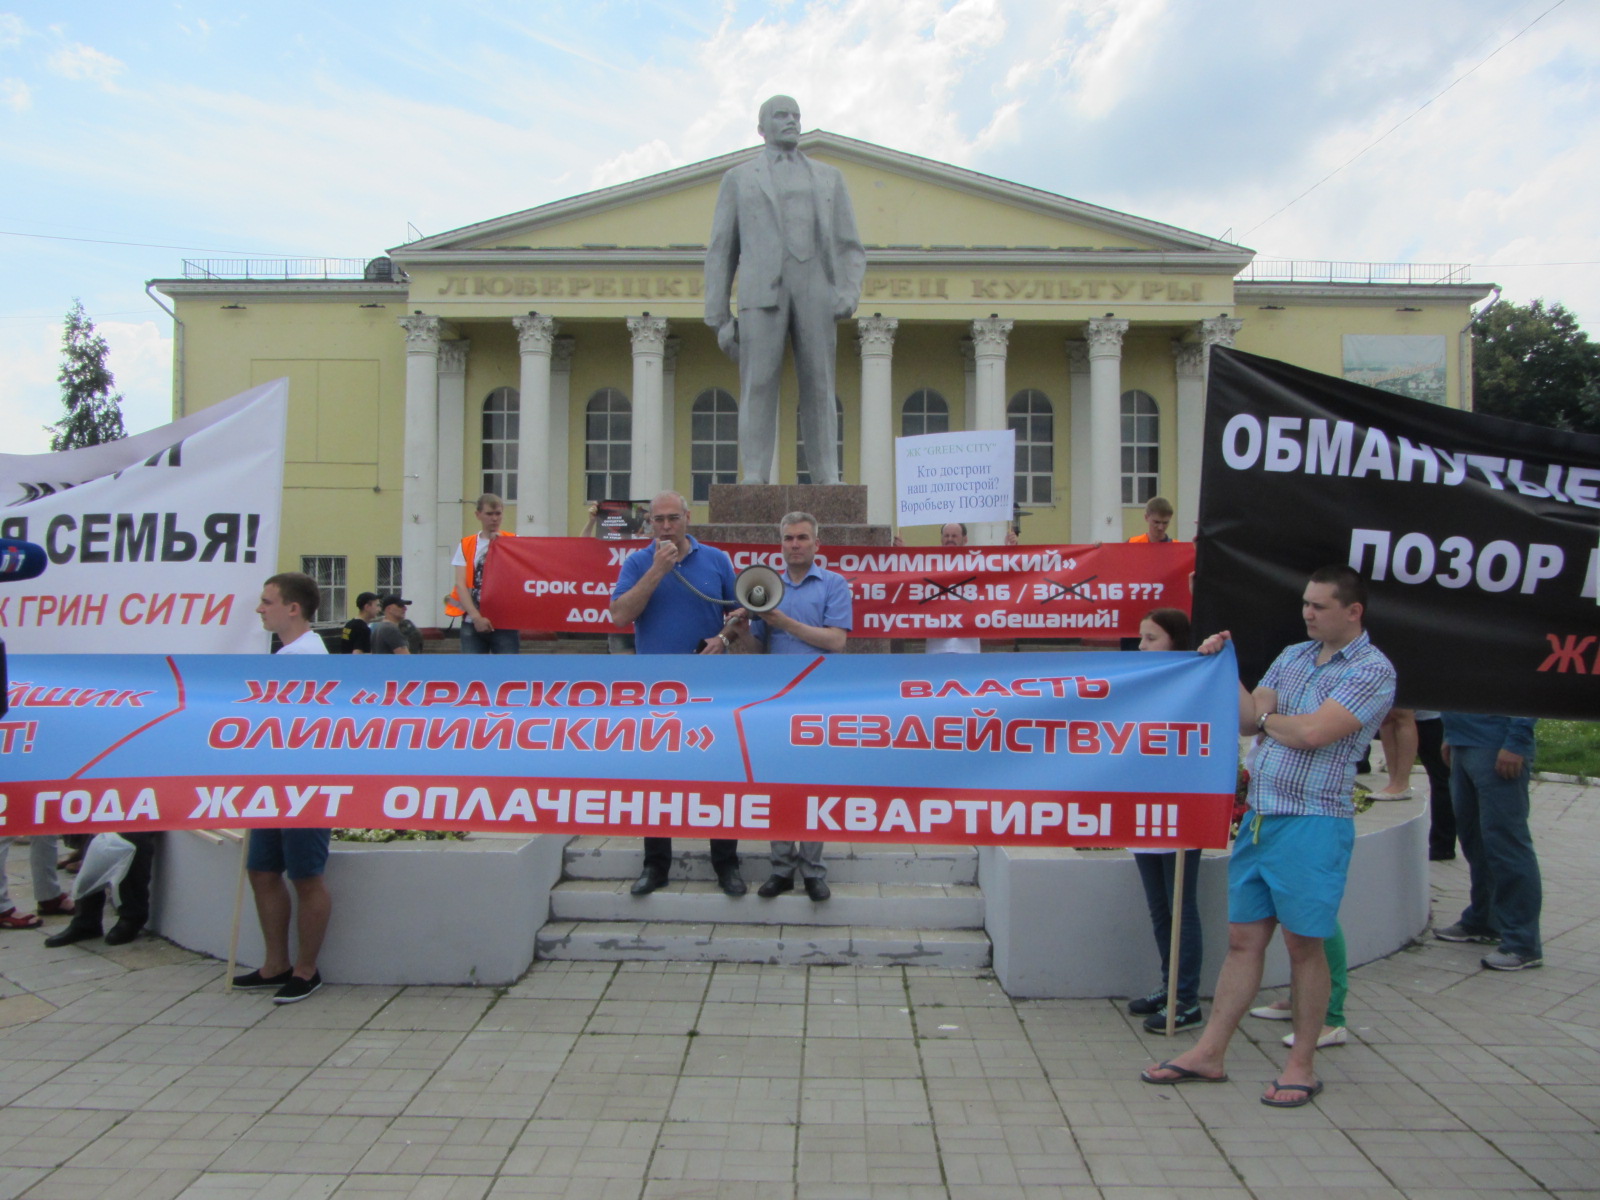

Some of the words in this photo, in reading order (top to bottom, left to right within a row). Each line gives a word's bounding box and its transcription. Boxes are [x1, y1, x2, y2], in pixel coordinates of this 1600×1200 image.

[437, 276, 704, 299] ЛЮБЕРЕЦК
[864, 277, 948, 300] РЕЦ
[971, 277, 1204, 302] КУЛЬТУРЫ
[917, 465, 937, 478] Кто
[940, 464, 991, 478] достроит
[1222, 413, 1600, 509] ОБМАНУТЫЕ
[907, 484, 927, 495] наш
[931, 477, 1000, 493] долгострой?
[900, 498, 955, 515] Воробьеву
[959, 494, 1009, 509] ПОЗОР!!!
[46, 512, 260, 565] СЕМЬЯ!
[607, 547, 638, 566] Ж
[1348, 528, 1564, 595] ПОЗОР
[909, 583, 1010, 601] 30.08.16
[1033, 583, 1123, 601] 30.11.16
[1128, 583, 1164, 600] ???
[18, 593, 109, 627] ГРИН
[119, 593, 236, 626] СИТИ
[566, 608, 614, 623] дол
[863, 612, 963, 632] пустых
[974, 609, 1119, 628] обещаний!
[7, 681, 158, 707] ЙЩИК
[231, 680, 341, 705] ЖК
[349, 680, 714, 708] «КРАСКОВО-
[899, 675, 1110, 700] ВЛАСТЬ
[0, 720, 39, 754] Т!
[208, 711, 716, 753] ОЛИМПИЙСКИЙ»
[789, 708, 1210, 757] БЕЗДЕЙСТВУЕТ!
[34, 787, 160, 825] ГОДА
[188, 785, 354, 820] ЖДУТ
[382, 786, 771, 829] ОПЛАЧЕННЫЕ
[806, 795, 1112, 837] КВАРТИРЫ
[1135, 803, 1179, 838] !!!
